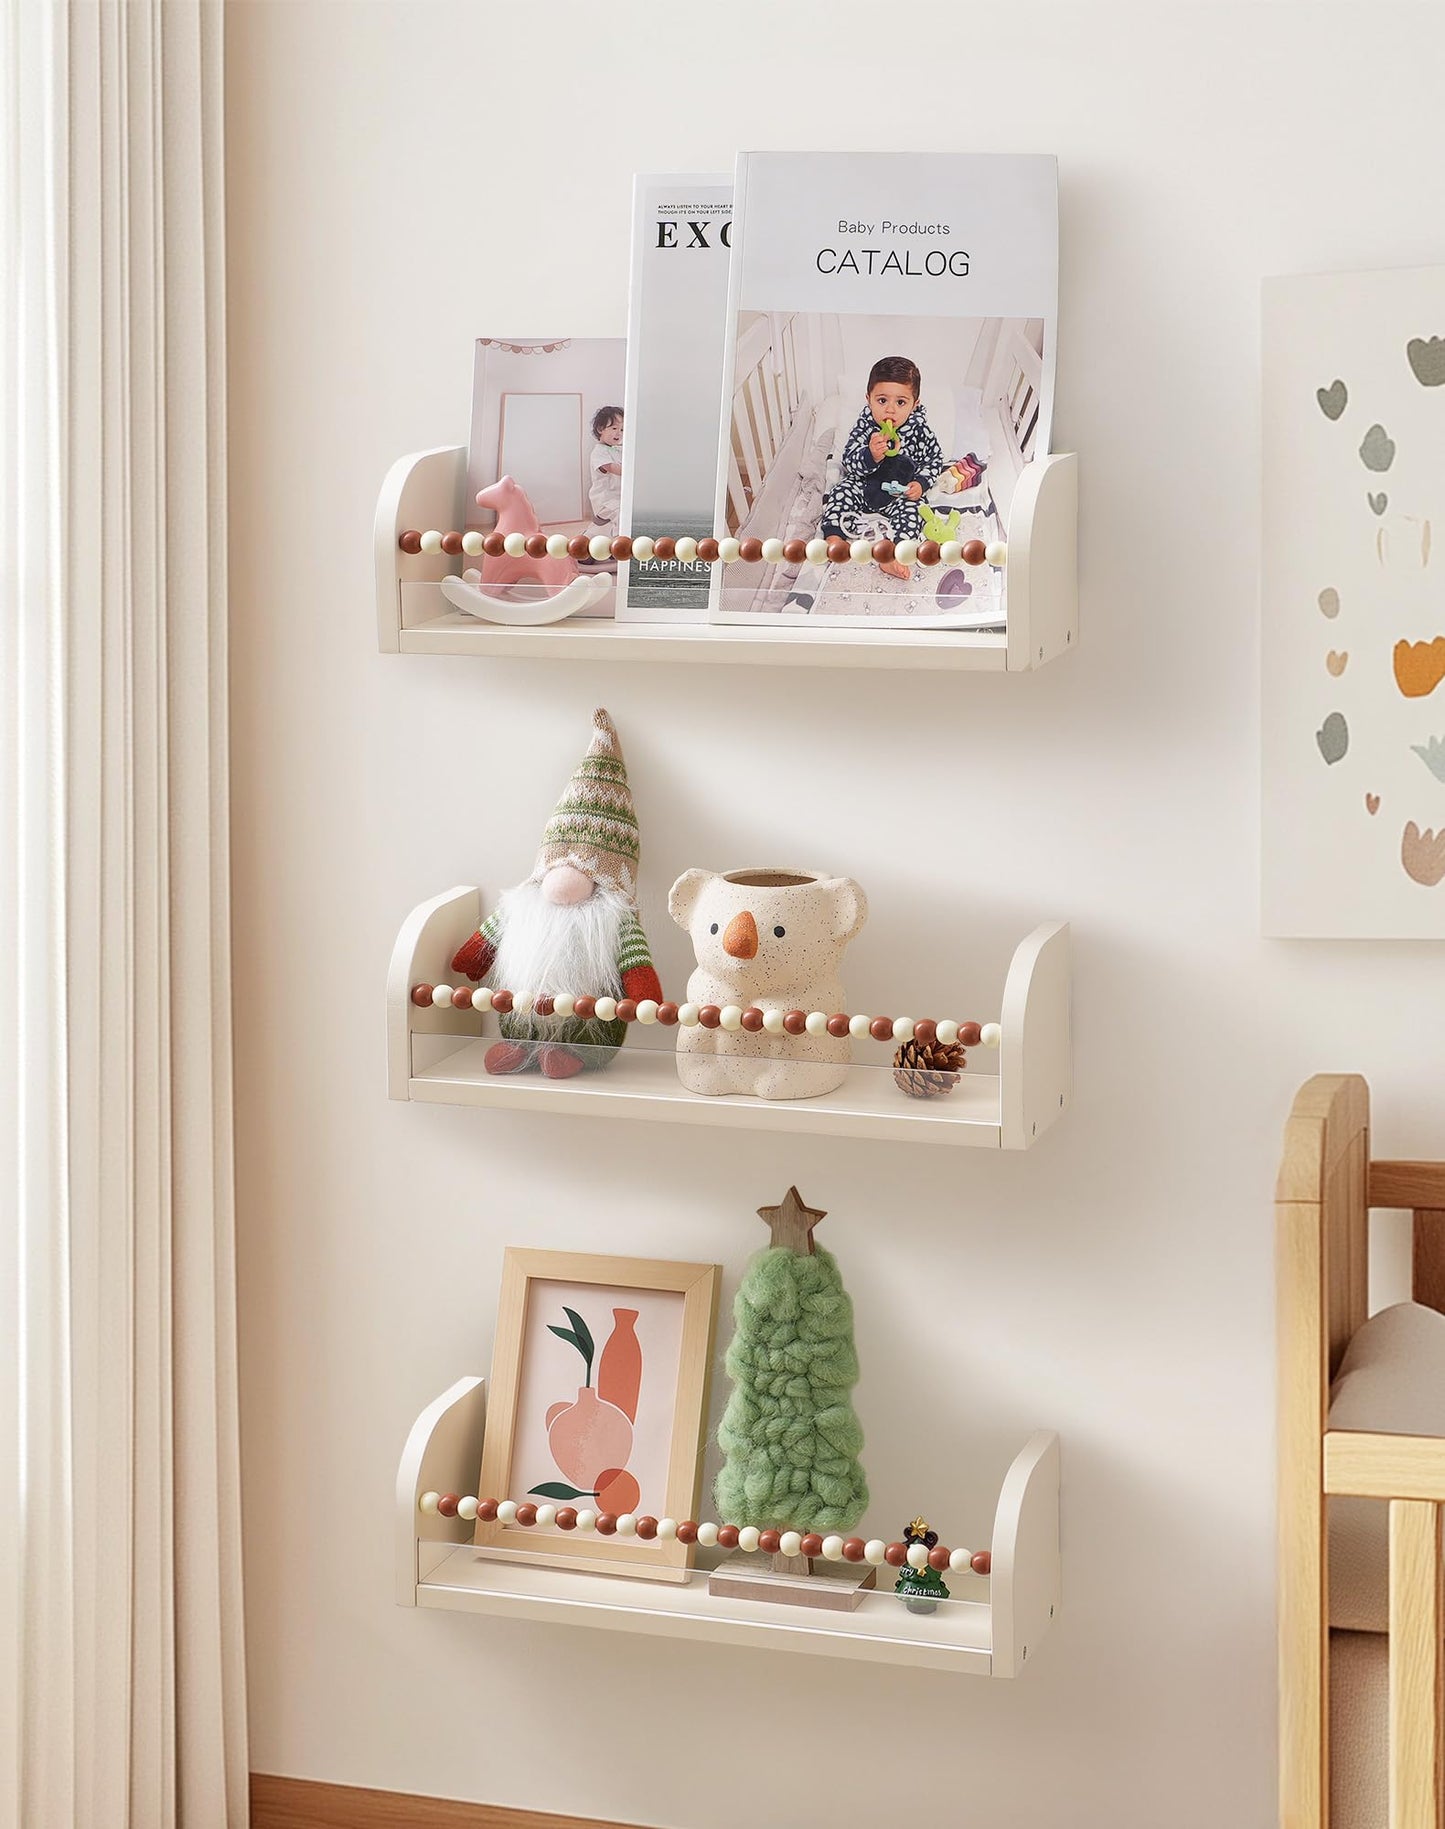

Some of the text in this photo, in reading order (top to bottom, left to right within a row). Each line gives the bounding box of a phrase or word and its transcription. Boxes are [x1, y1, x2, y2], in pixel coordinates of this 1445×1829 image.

[838, 220, 951, 235] Baby Products
[816, 249, 970, 277] CATALOG
[639, 560, 712, 572] HAPPINES
